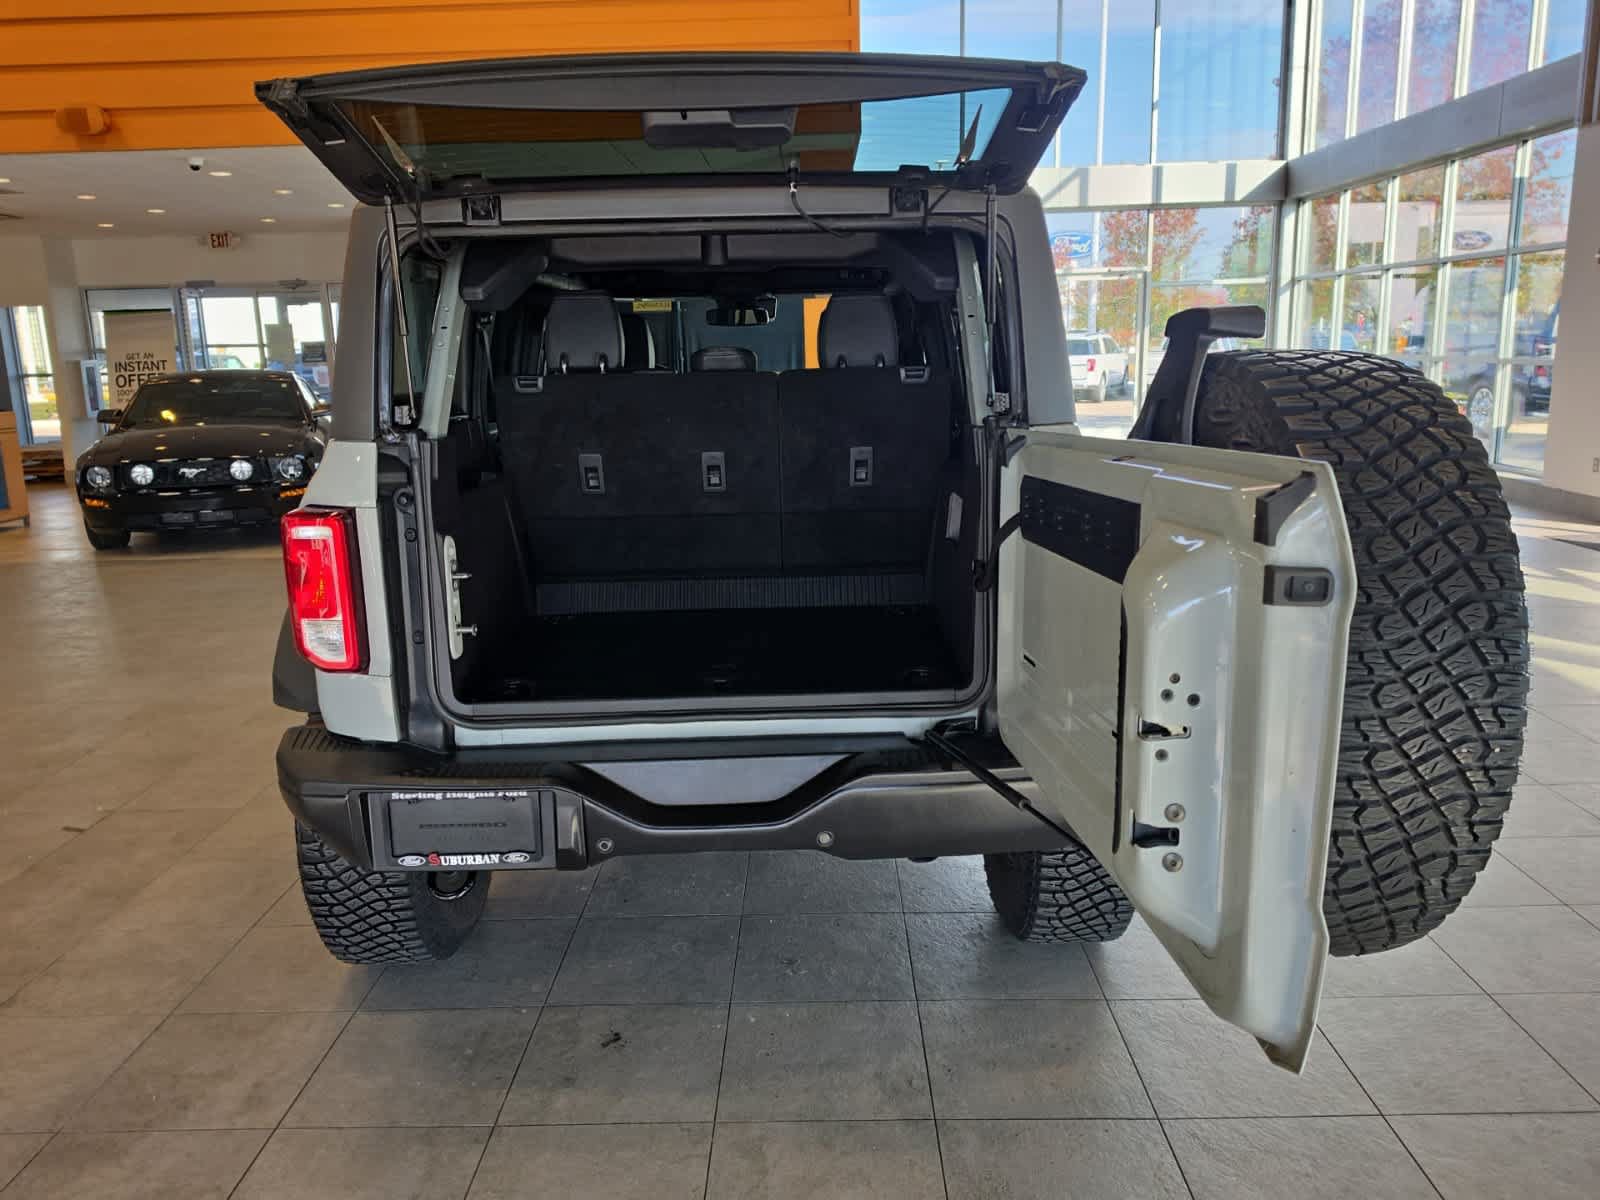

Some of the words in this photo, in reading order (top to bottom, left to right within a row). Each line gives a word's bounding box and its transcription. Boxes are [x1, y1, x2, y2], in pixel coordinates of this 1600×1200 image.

[210, 232, 229, 249] EXIT
[126, 352, 140, 360] GET
[143, 352, 154, 360] AN
[114, 360, 167, 373] INSTANT
[115, 373, 164, 387] OFF
[392, 792, 443, 800] Sterling
[428, 853, 500, 866] SUBURBAN
